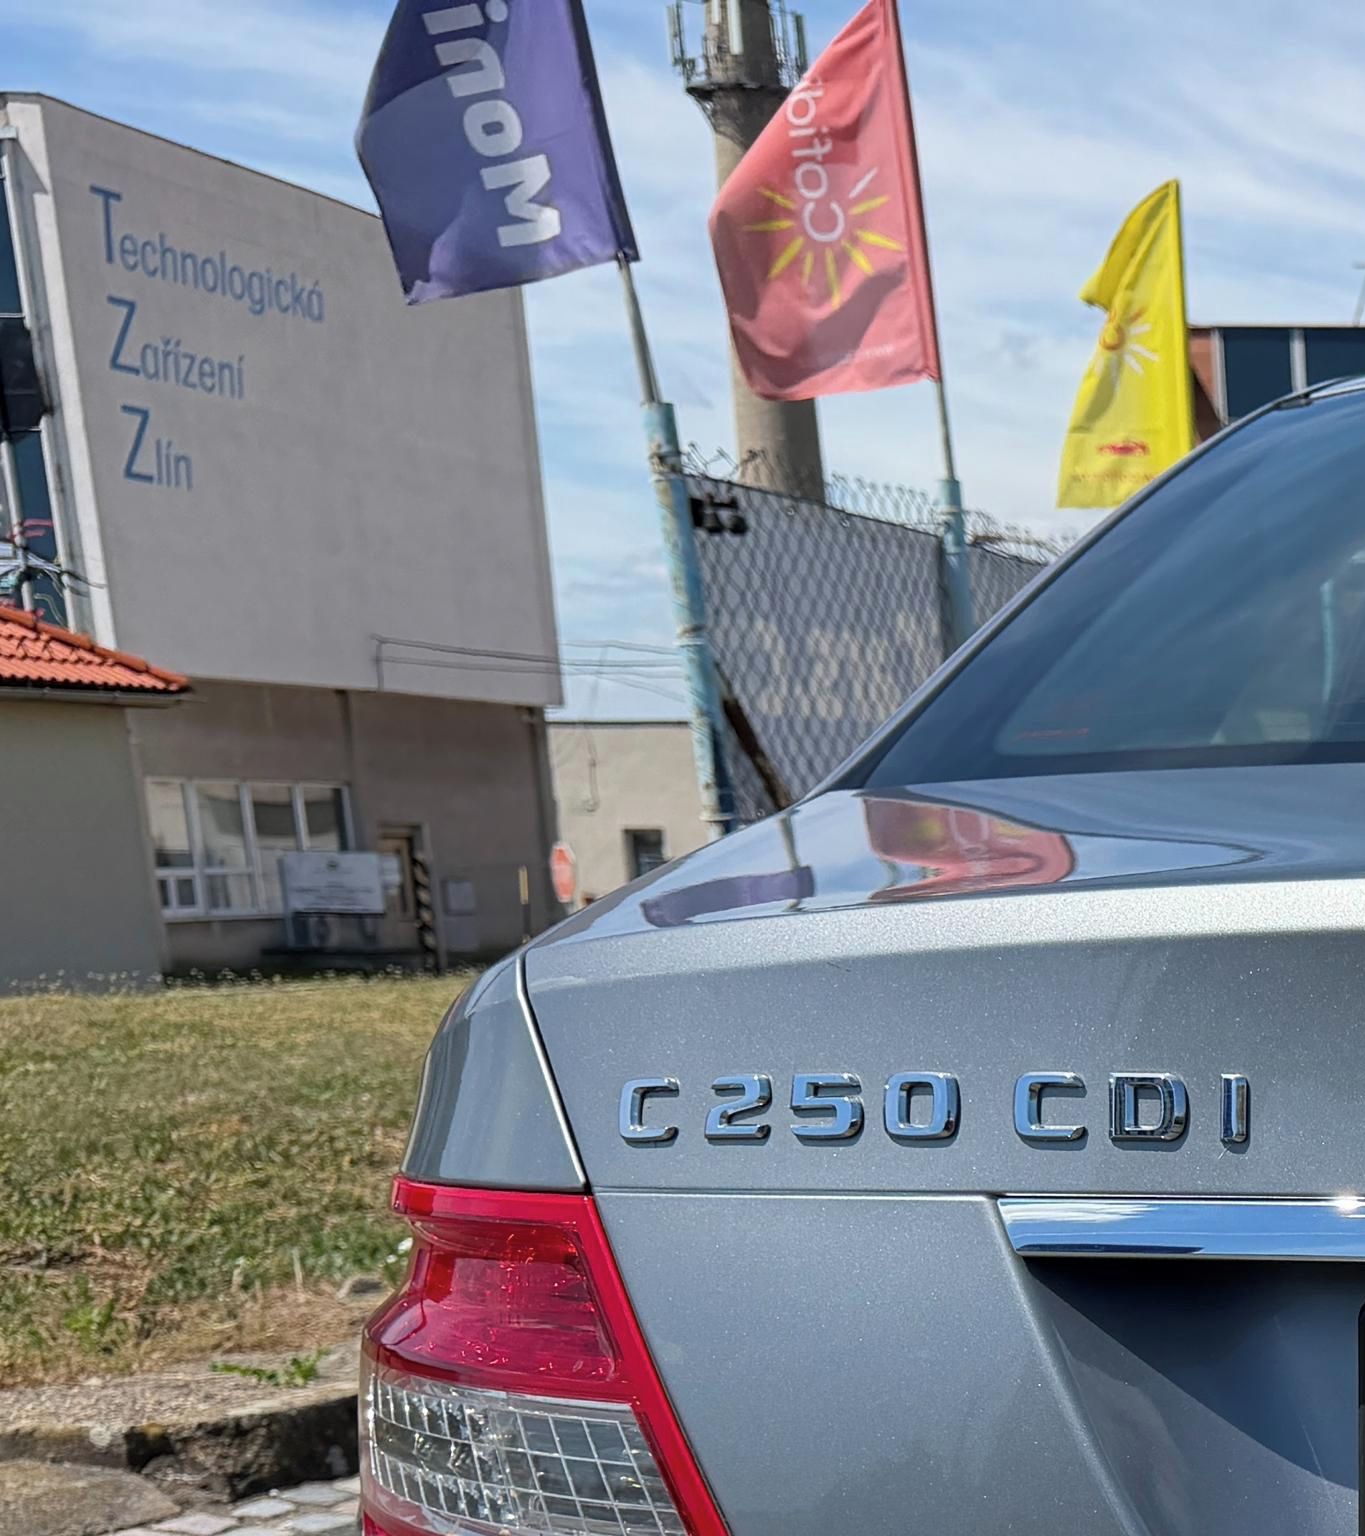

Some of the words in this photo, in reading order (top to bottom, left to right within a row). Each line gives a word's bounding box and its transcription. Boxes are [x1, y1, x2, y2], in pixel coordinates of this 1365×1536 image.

[89, 184, 326, 322] Technologická
[106, 295, 245, 400] Zařízení
[119, 403, 194, 492] Zlín
[1013, 1071, 1251, 1143] CDI
